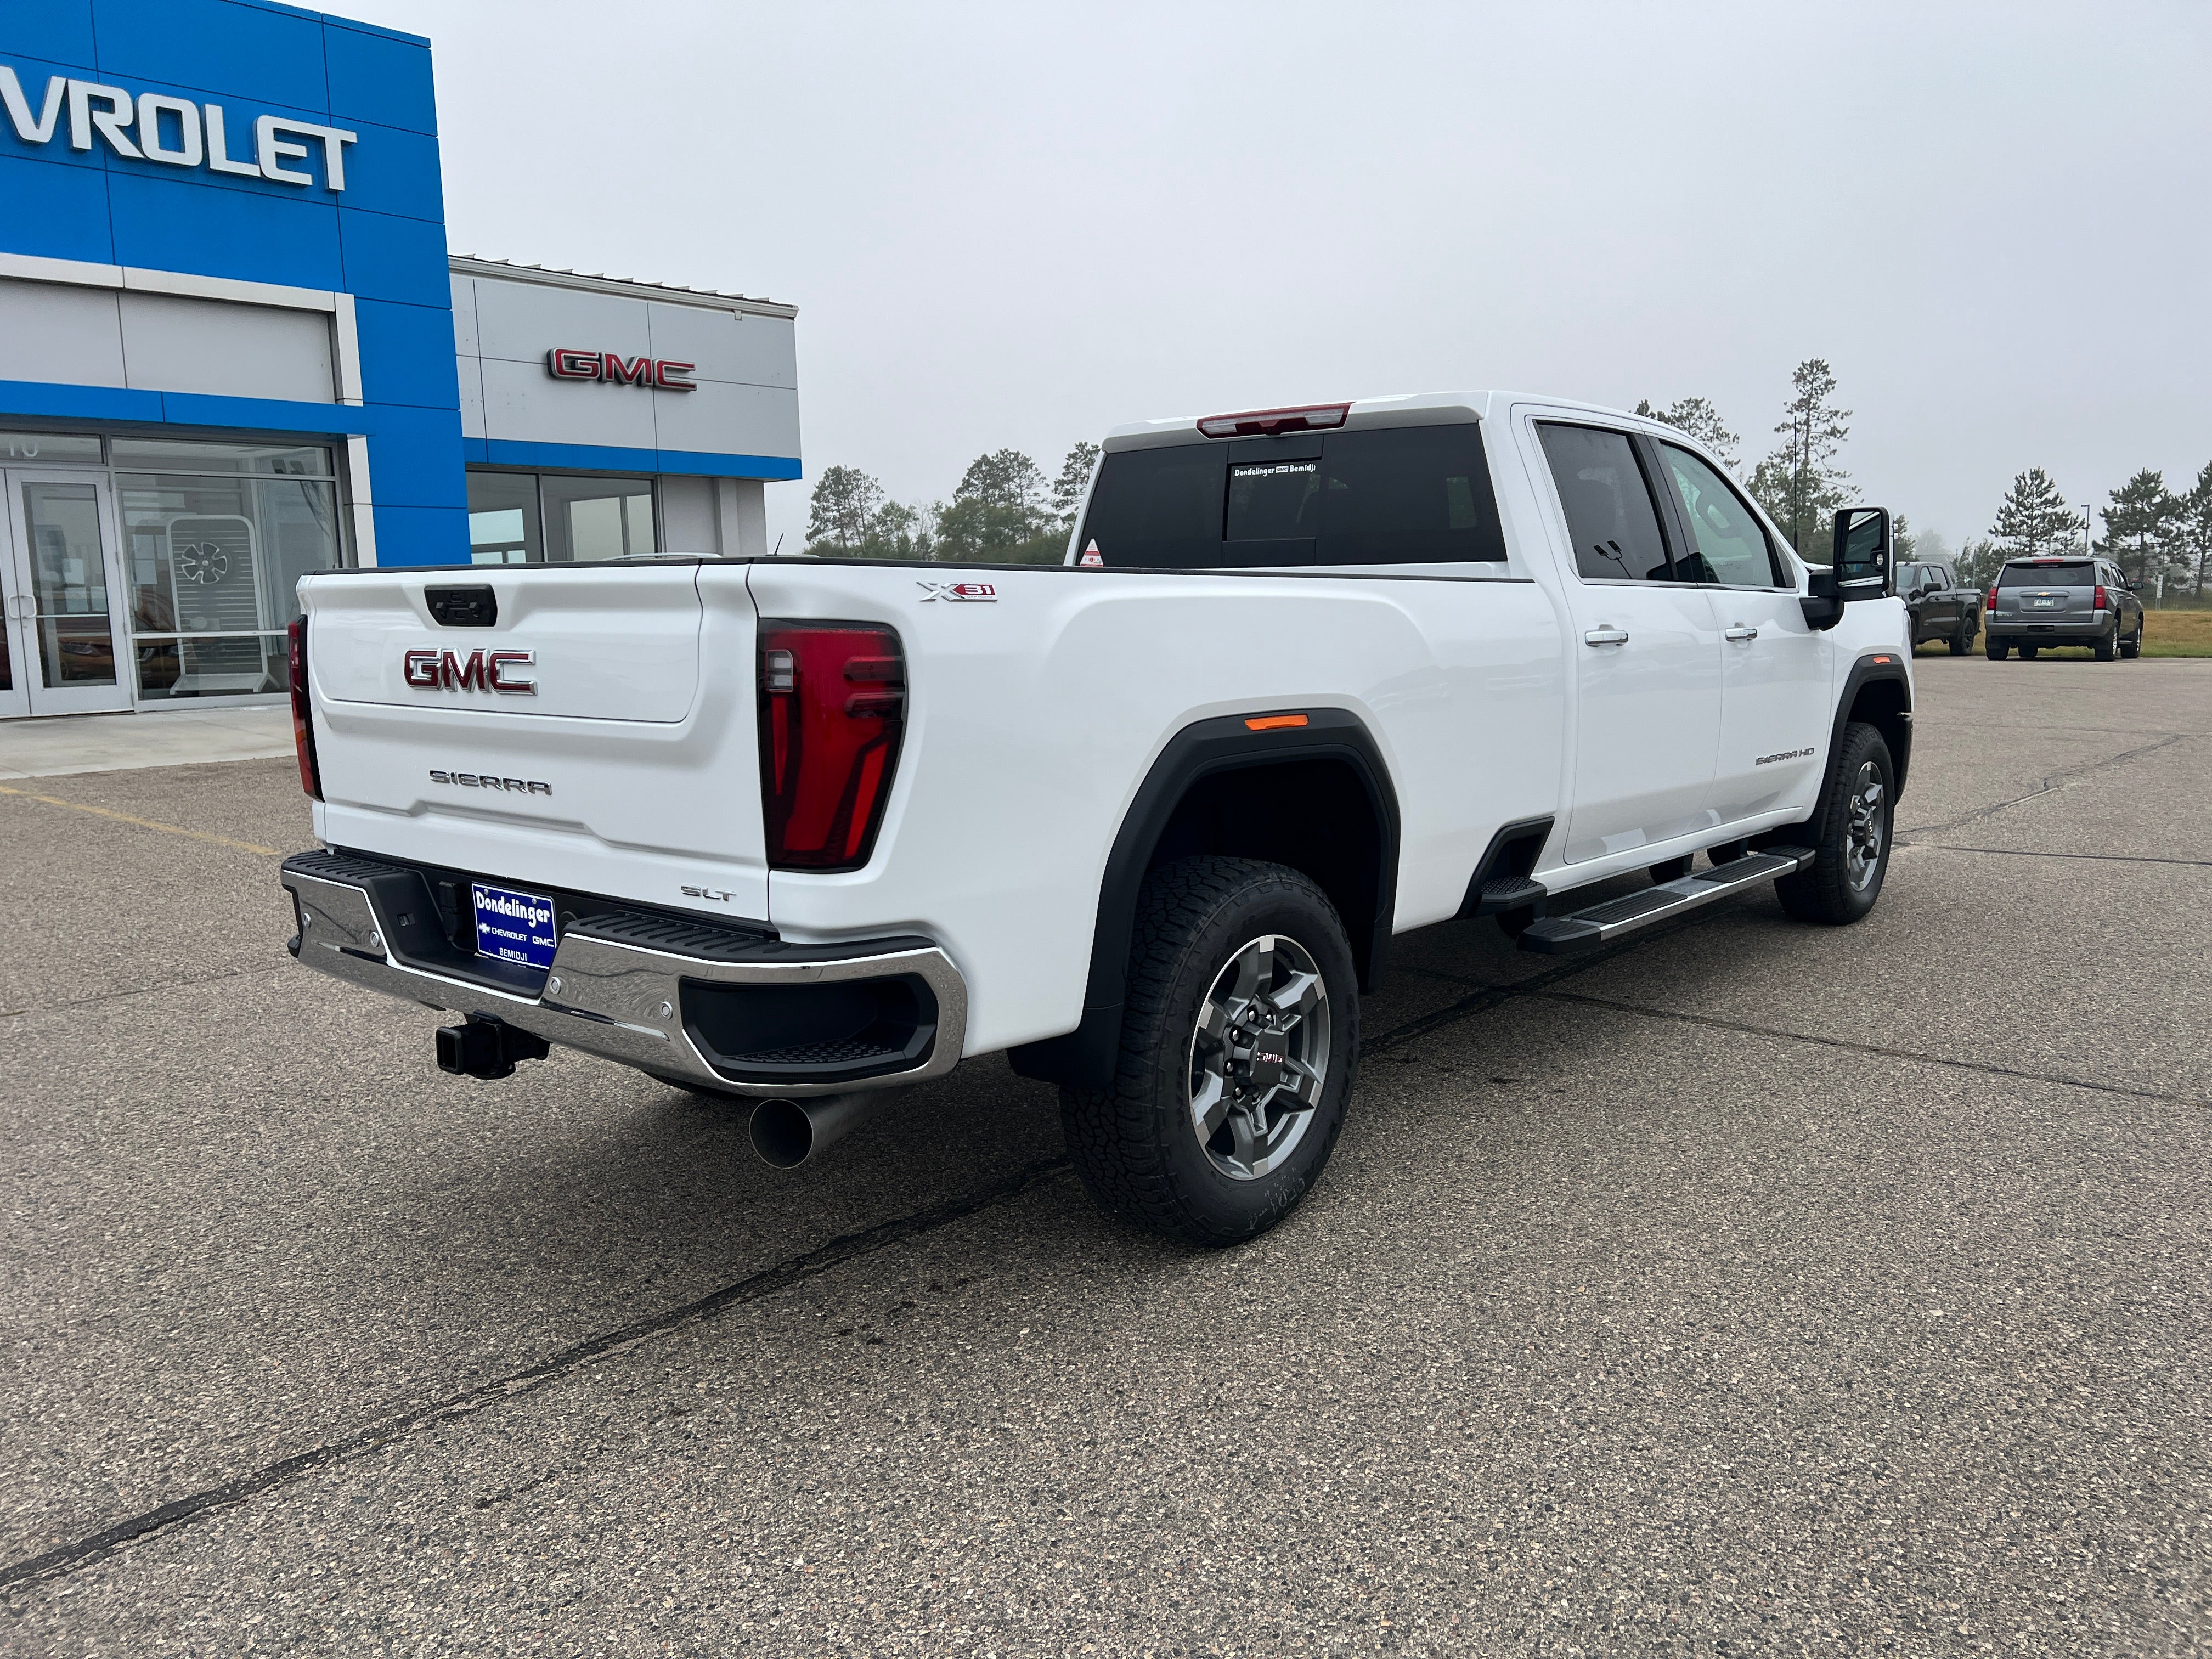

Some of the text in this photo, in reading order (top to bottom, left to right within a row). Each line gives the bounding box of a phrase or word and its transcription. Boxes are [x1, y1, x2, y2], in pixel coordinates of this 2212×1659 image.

[547, 347, 697, 391] GMC
[1234, 467, 1275, 477] Dondelinger
[916, 582, 996, 602] X31
[404, 648, 538, 696] GMC
[1756, 748, 1815, 765] SIERRA HD
[429, 770, 552, 795] SIERRA
[681, 883, 737, 902] SLT
[475, 890, 550, 928] Dondelinger
[492, 927, 554, 947] CHEVROLET GMC
[499, 947, 527, 961] BEMIDJI
